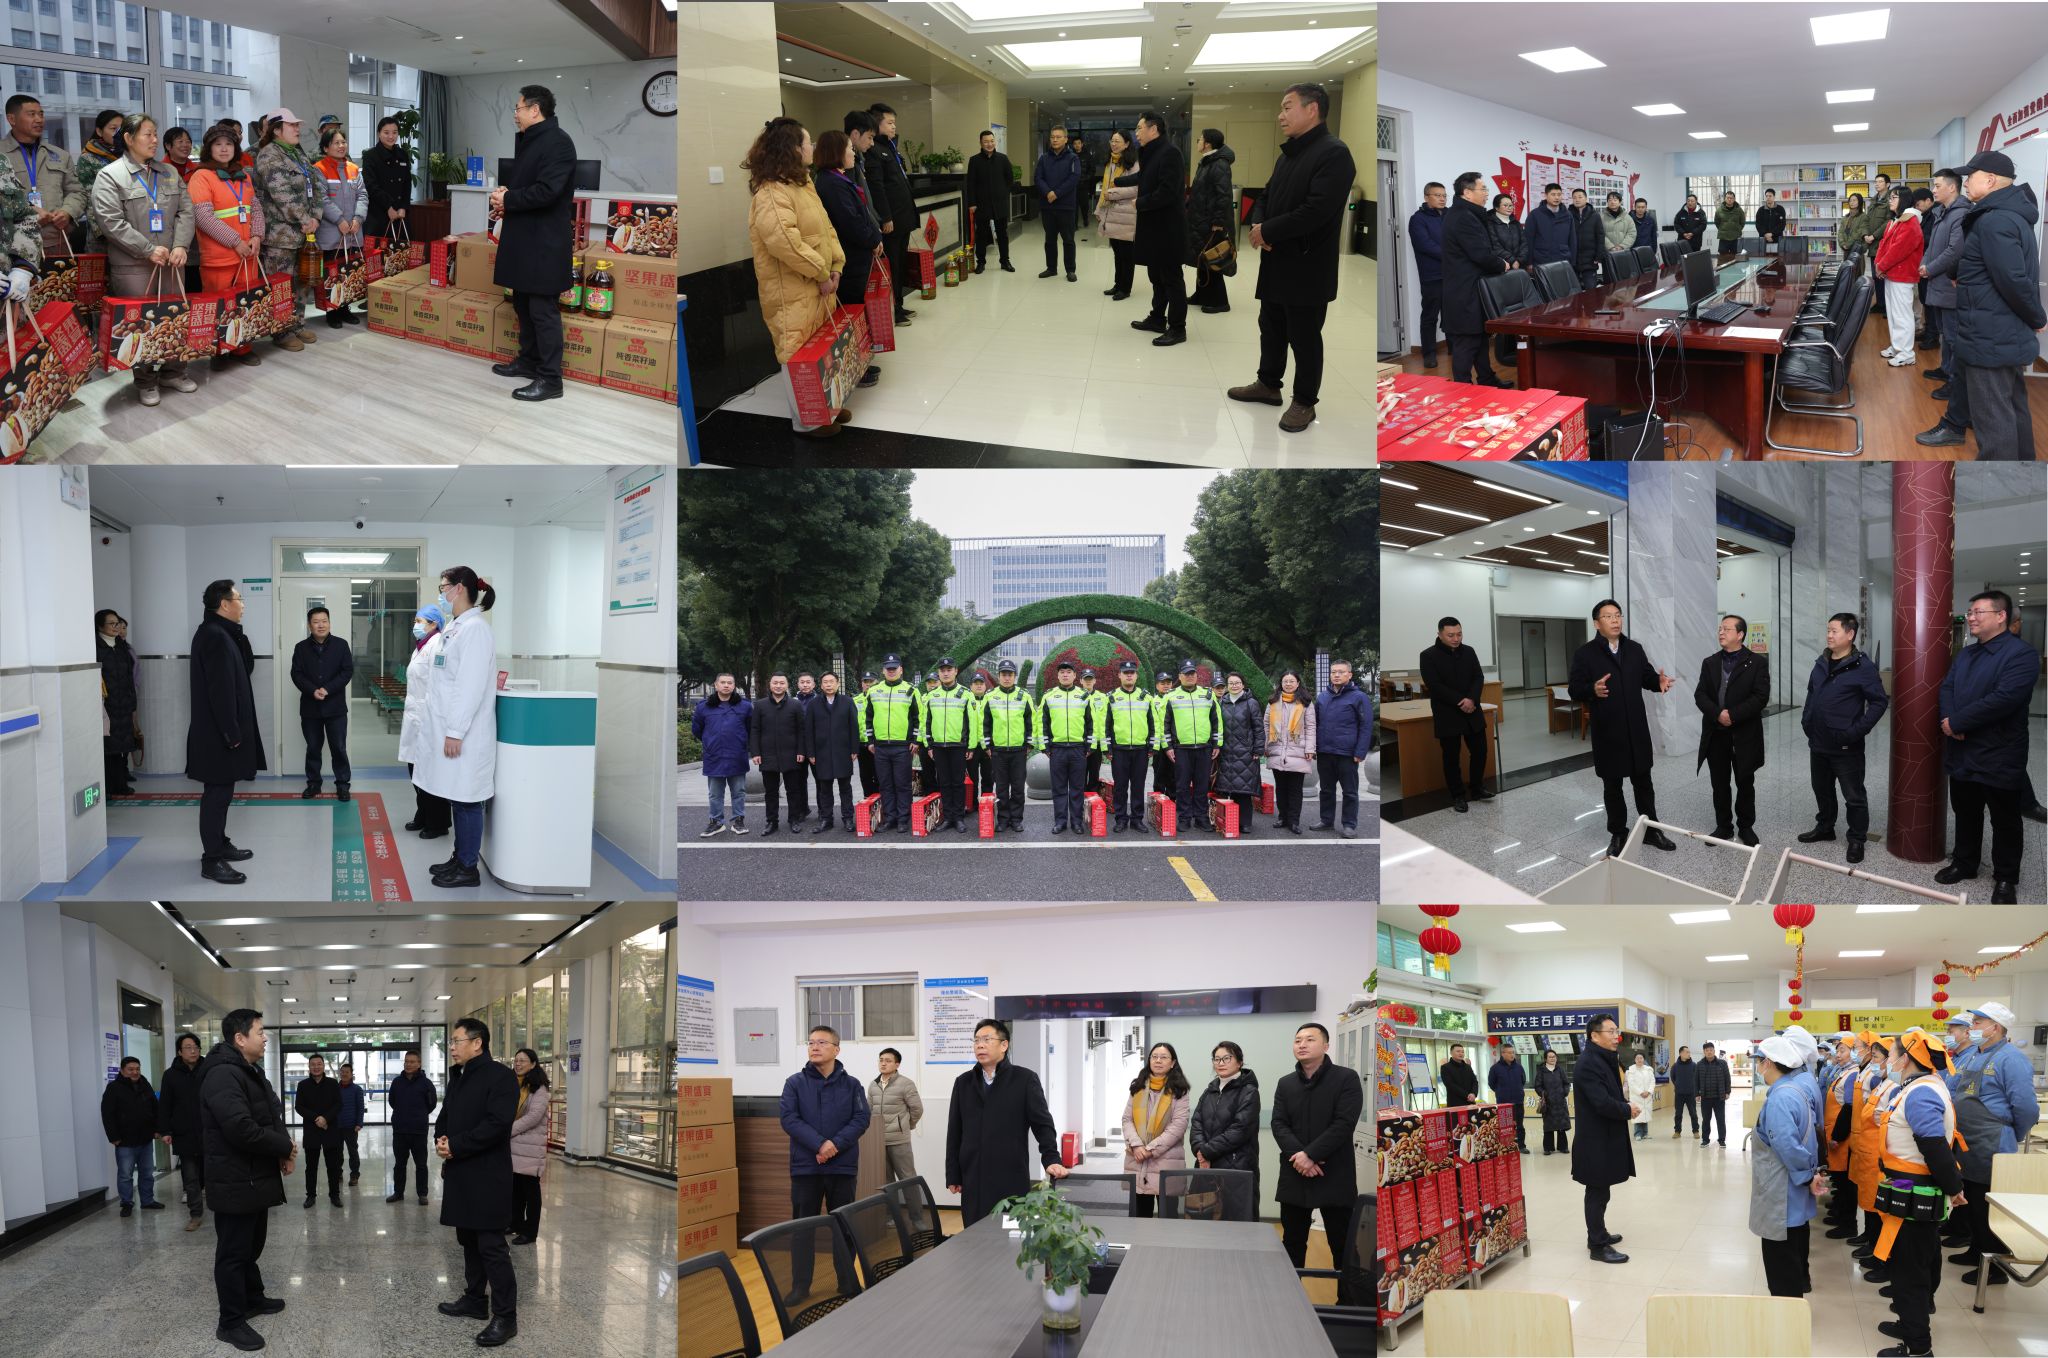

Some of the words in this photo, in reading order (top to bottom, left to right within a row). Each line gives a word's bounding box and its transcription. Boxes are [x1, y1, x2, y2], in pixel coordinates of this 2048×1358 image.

[624, 269, 675, 288] 坚果盛
[616, 351, 657, 367] 纯香菜籽油
[1506, 1015, 1592, 1028] 米先生石磨手工
[680, 1179, 718, 1197] 坚果盛宴
[684, 1224, 718, 1247] 坚果盛宴
